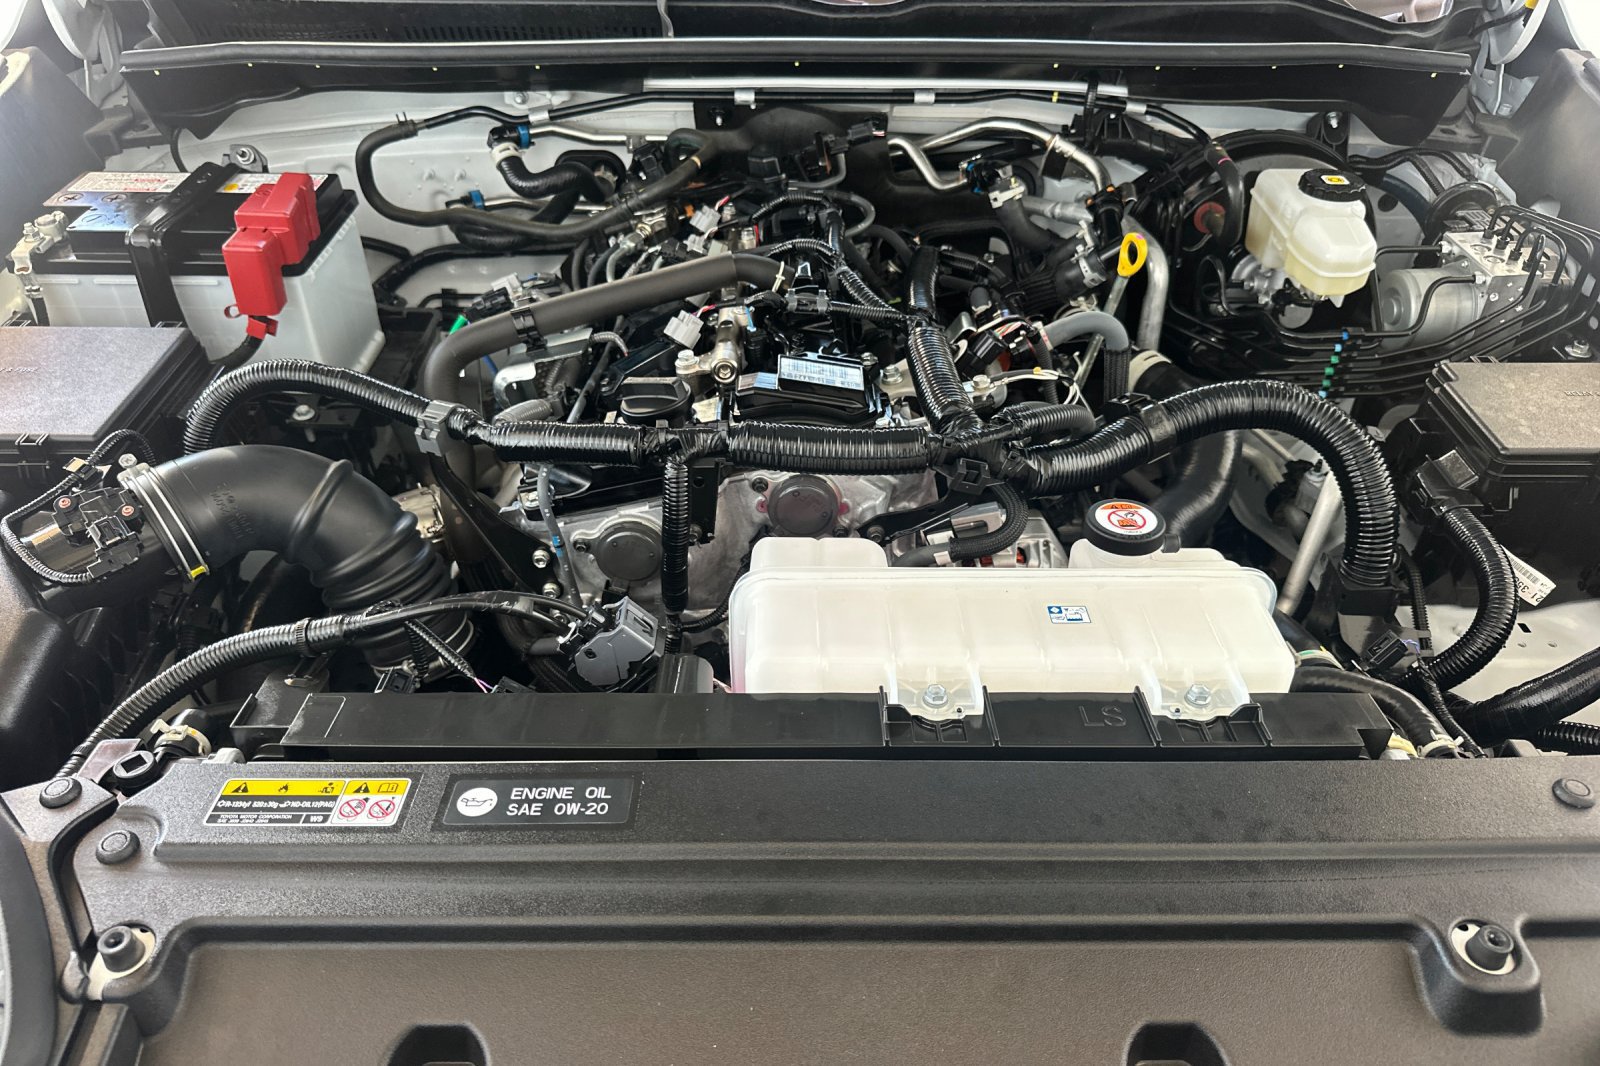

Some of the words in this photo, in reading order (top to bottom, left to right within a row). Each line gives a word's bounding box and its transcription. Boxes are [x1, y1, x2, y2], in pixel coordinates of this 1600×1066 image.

[1079, 705, 1127, 727] LS
[510, 787, 575, 800] ENGINE
[585, 786, 612, 799] OIL
[506, 803, 544, 816] SAE
[554, 802, 609, 815] 0W-20
[310, 815, 324, 823] W9
